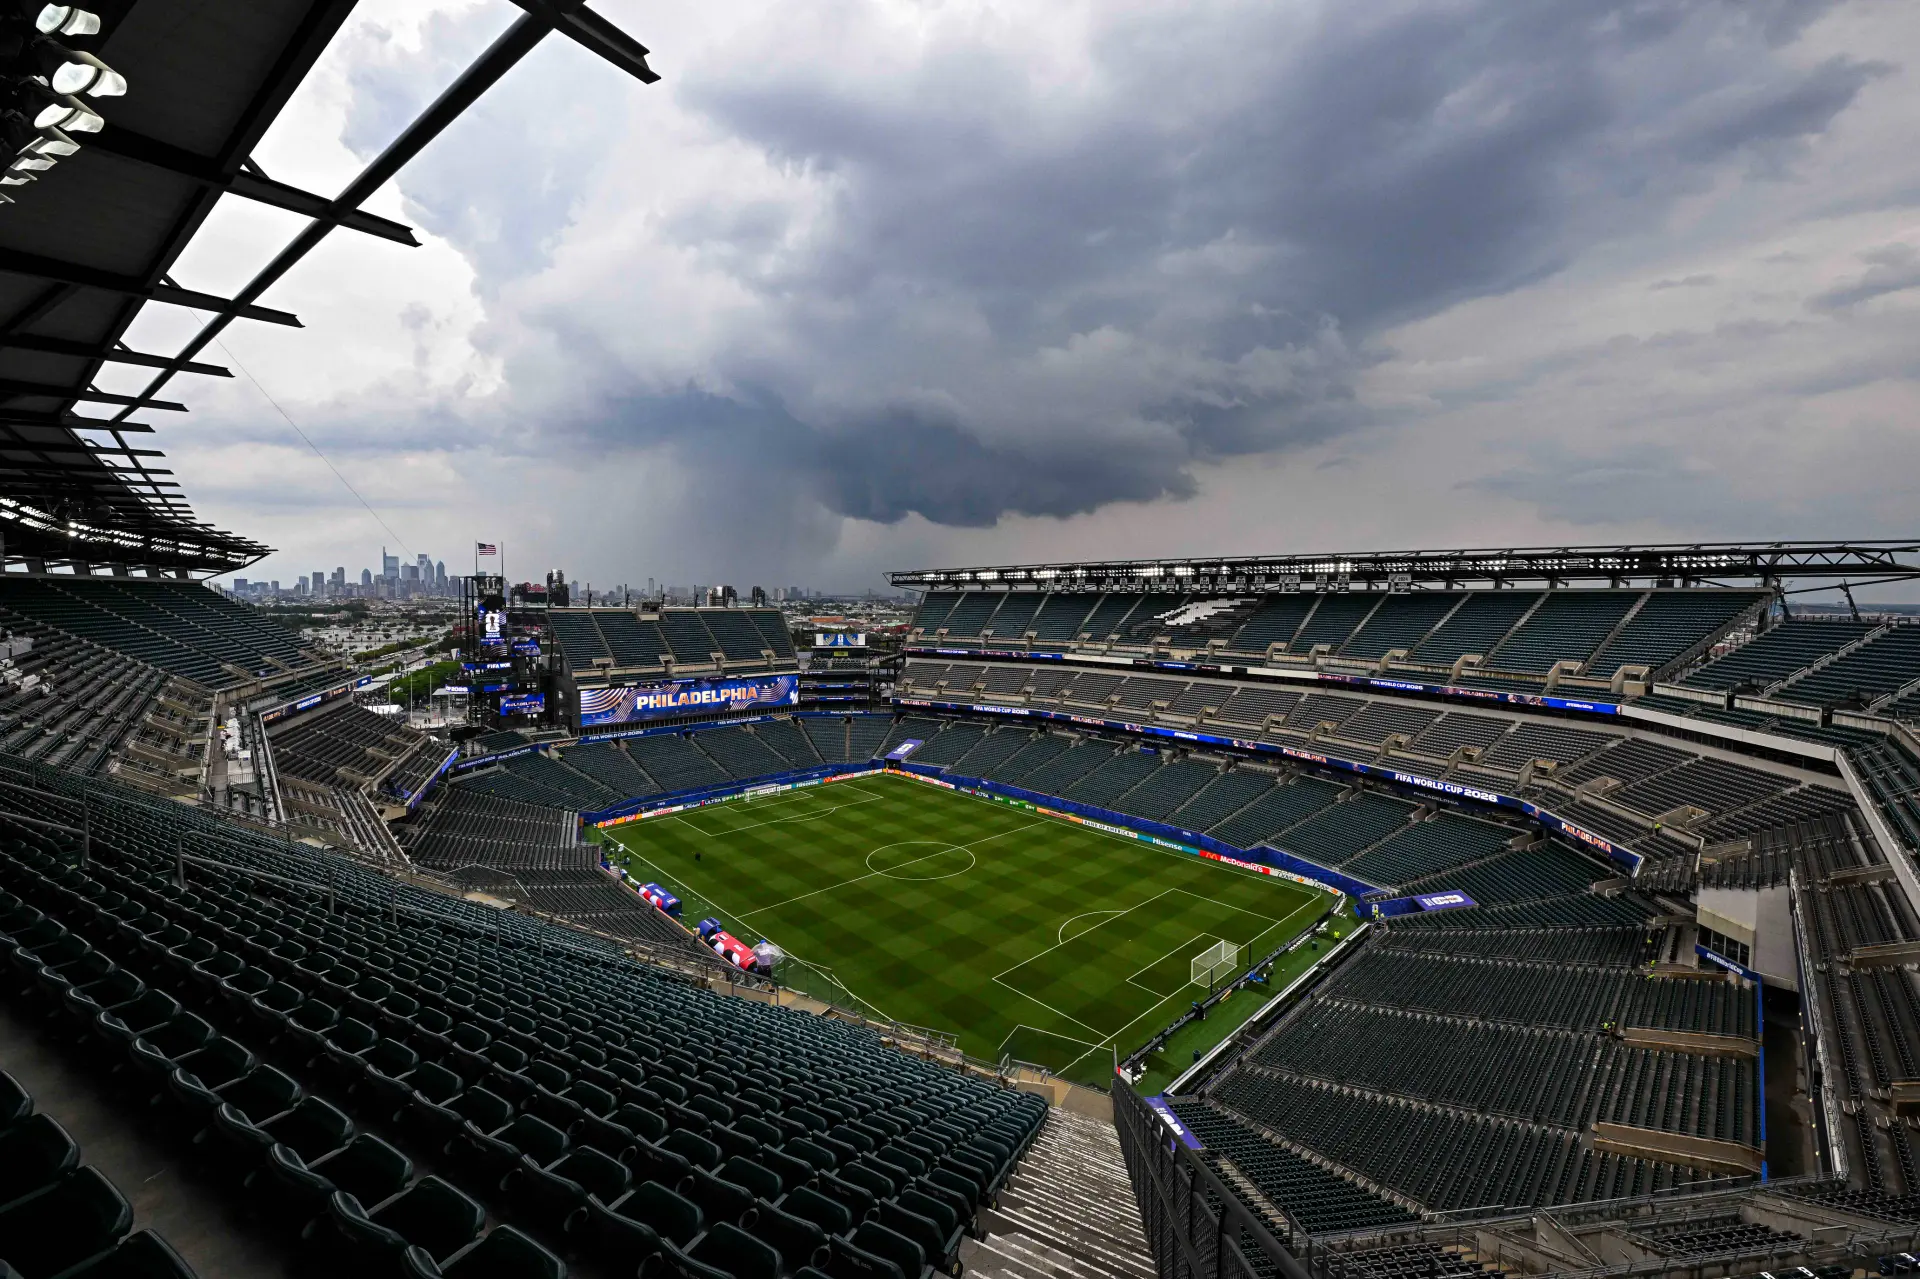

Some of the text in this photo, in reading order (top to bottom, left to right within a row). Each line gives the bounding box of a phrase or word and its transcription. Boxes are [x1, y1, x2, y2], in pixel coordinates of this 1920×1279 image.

[637, 687, 757, 709] PHILADELPHIA
[1459, 690, 1498, 699] PHILADELPHIA
[1071, 715, 1104, 726] PHILADELPHIA
[1283, 748, 1327, 763] PHILADELPHIA
[796, 779, 818, 788] Hisense
[1395, 773, 1498, 803] FIFA WORLD CUP 2026
[975, 790, 989, 798] ULTRA
[1413, 791, 1459, 806] PHILADELPHIA
[1084, 820, 1098, 828] BANK
[1106, 826, 1130, 837] AMERICA
[1152, 837, 1182, 851] Hisense
[1561, 822, 1612, 854] PHILADELPHIA
[1220, 855, 1263, 873] McDonald's
